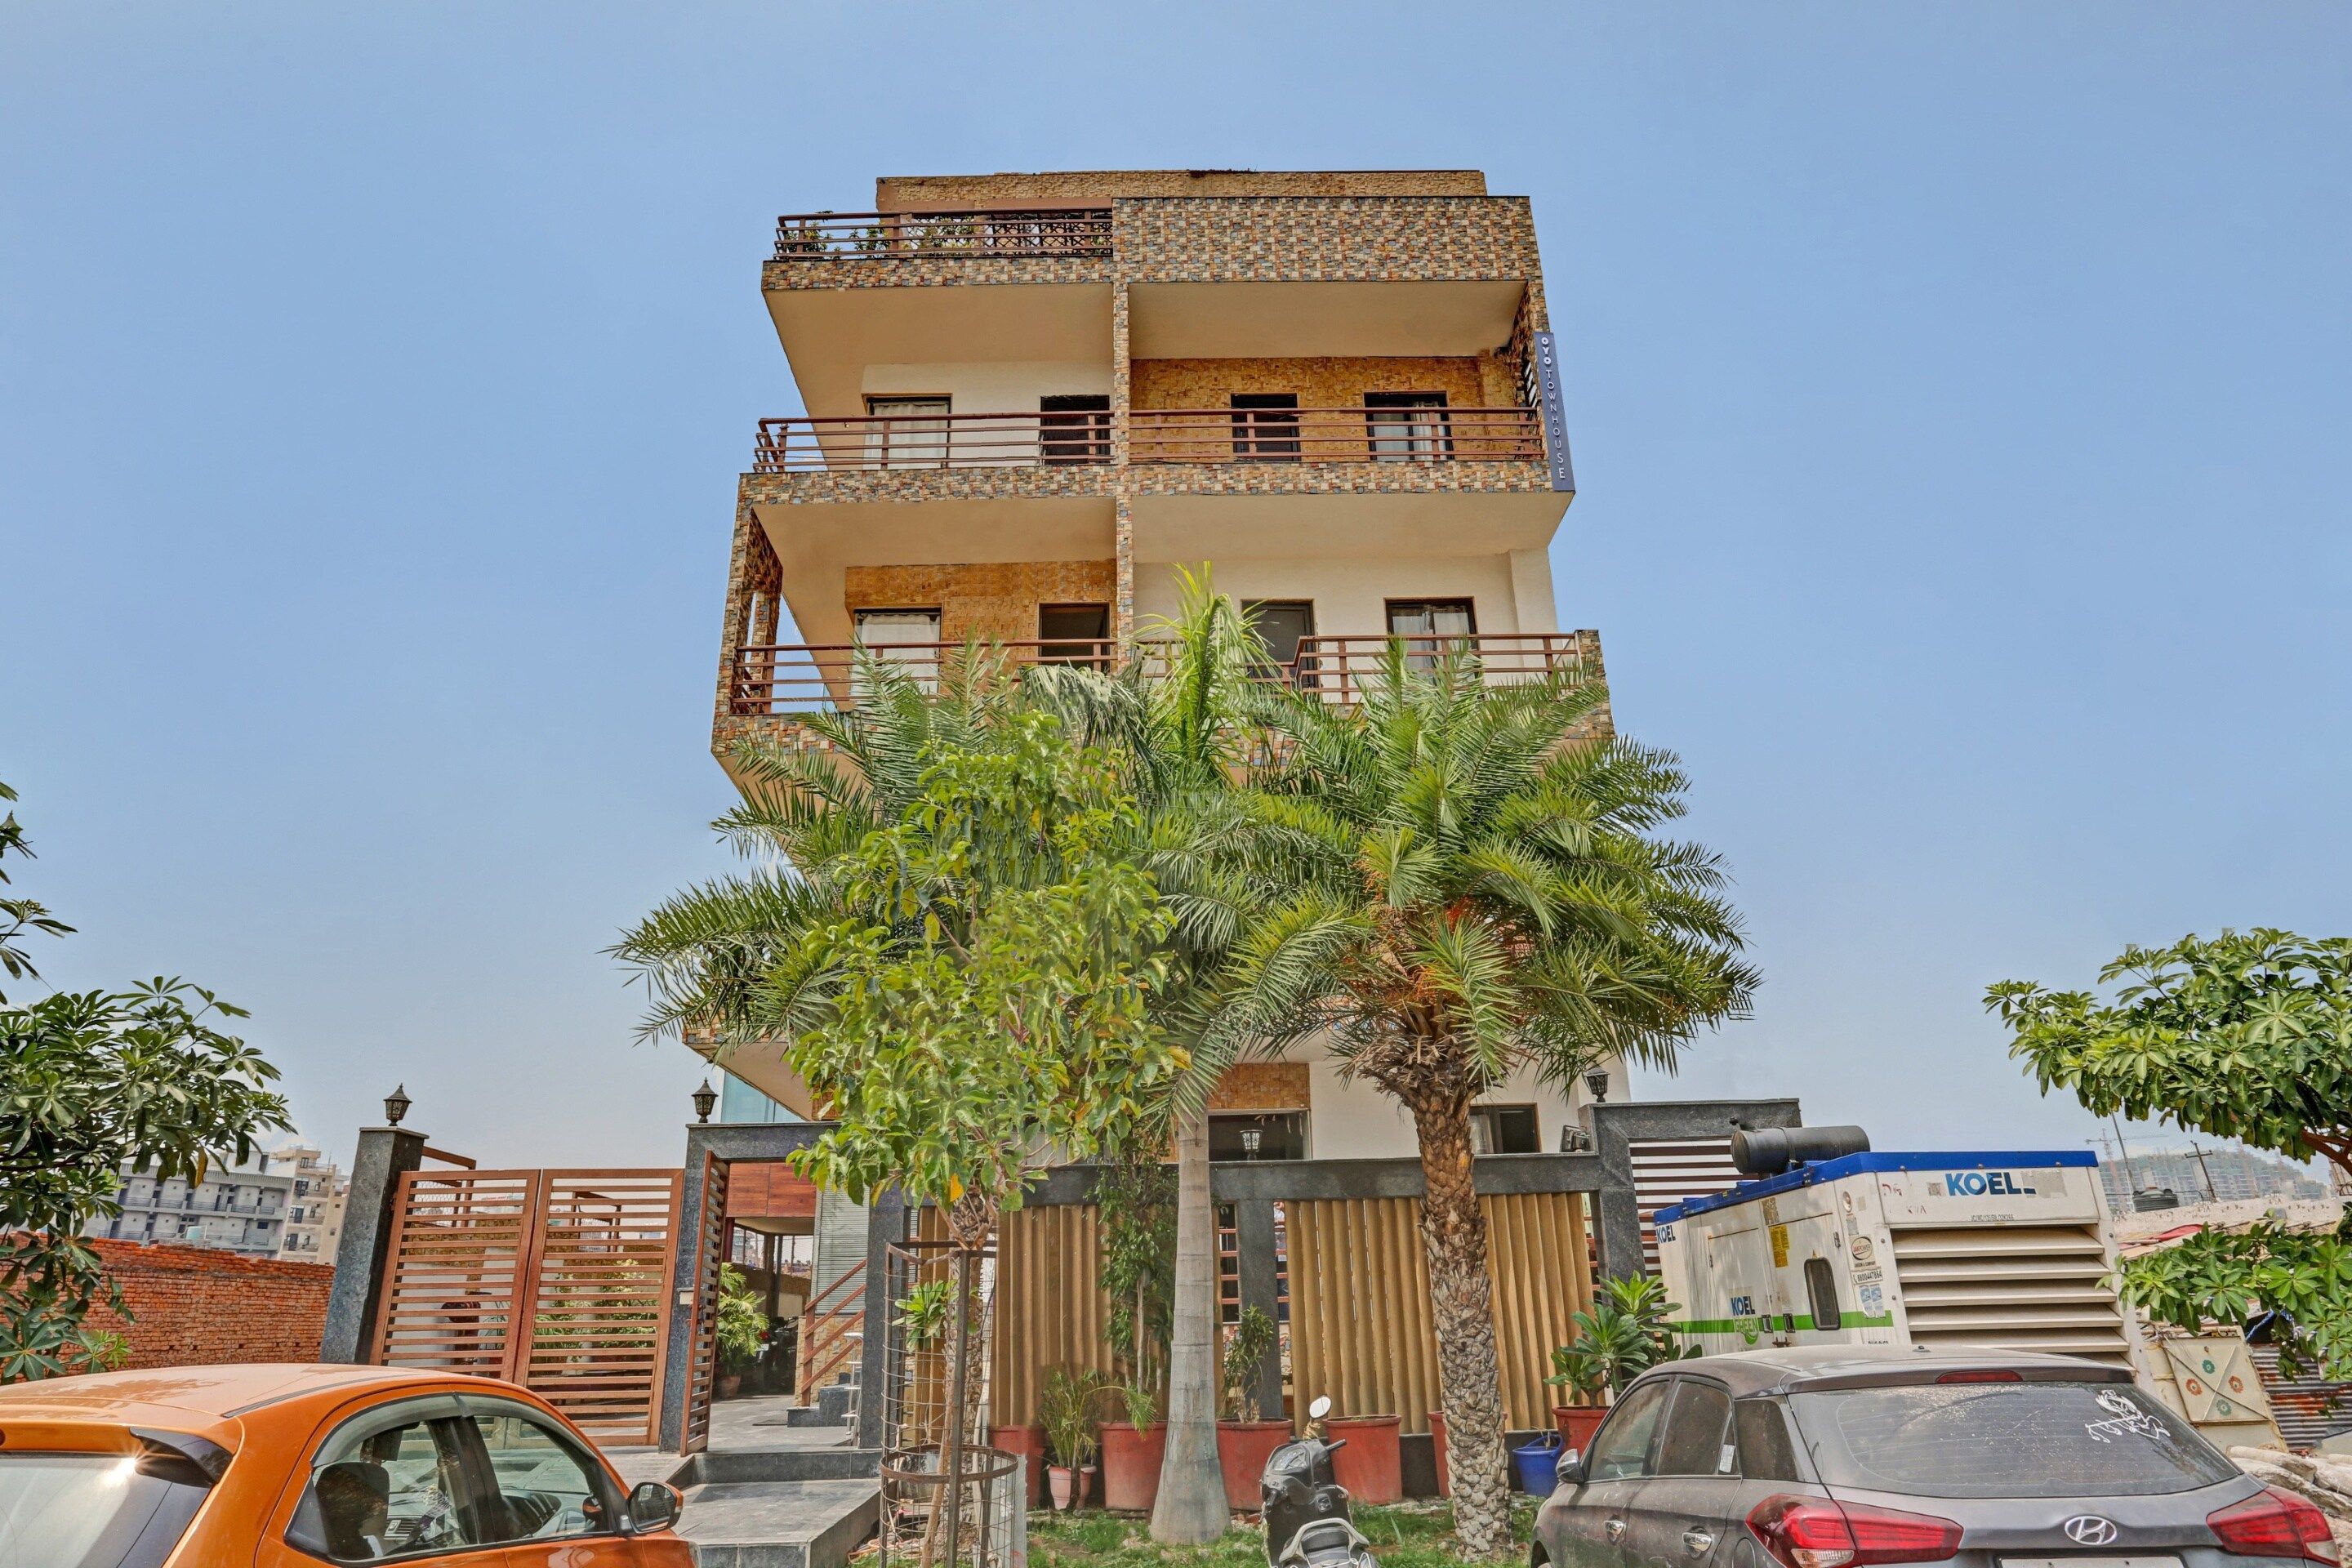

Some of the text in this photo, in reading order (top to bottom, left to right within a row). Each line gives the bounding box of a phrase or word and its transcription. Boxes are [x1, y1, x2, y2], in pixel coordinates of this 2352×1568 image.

[1541, 336, 1552, 365] OYO
[1945, 1172, 2022, 1196] KOEL
[1656, 1224, 1676, 1244] KOEL
[1731, 1295, 1756, 1316] KOEL
